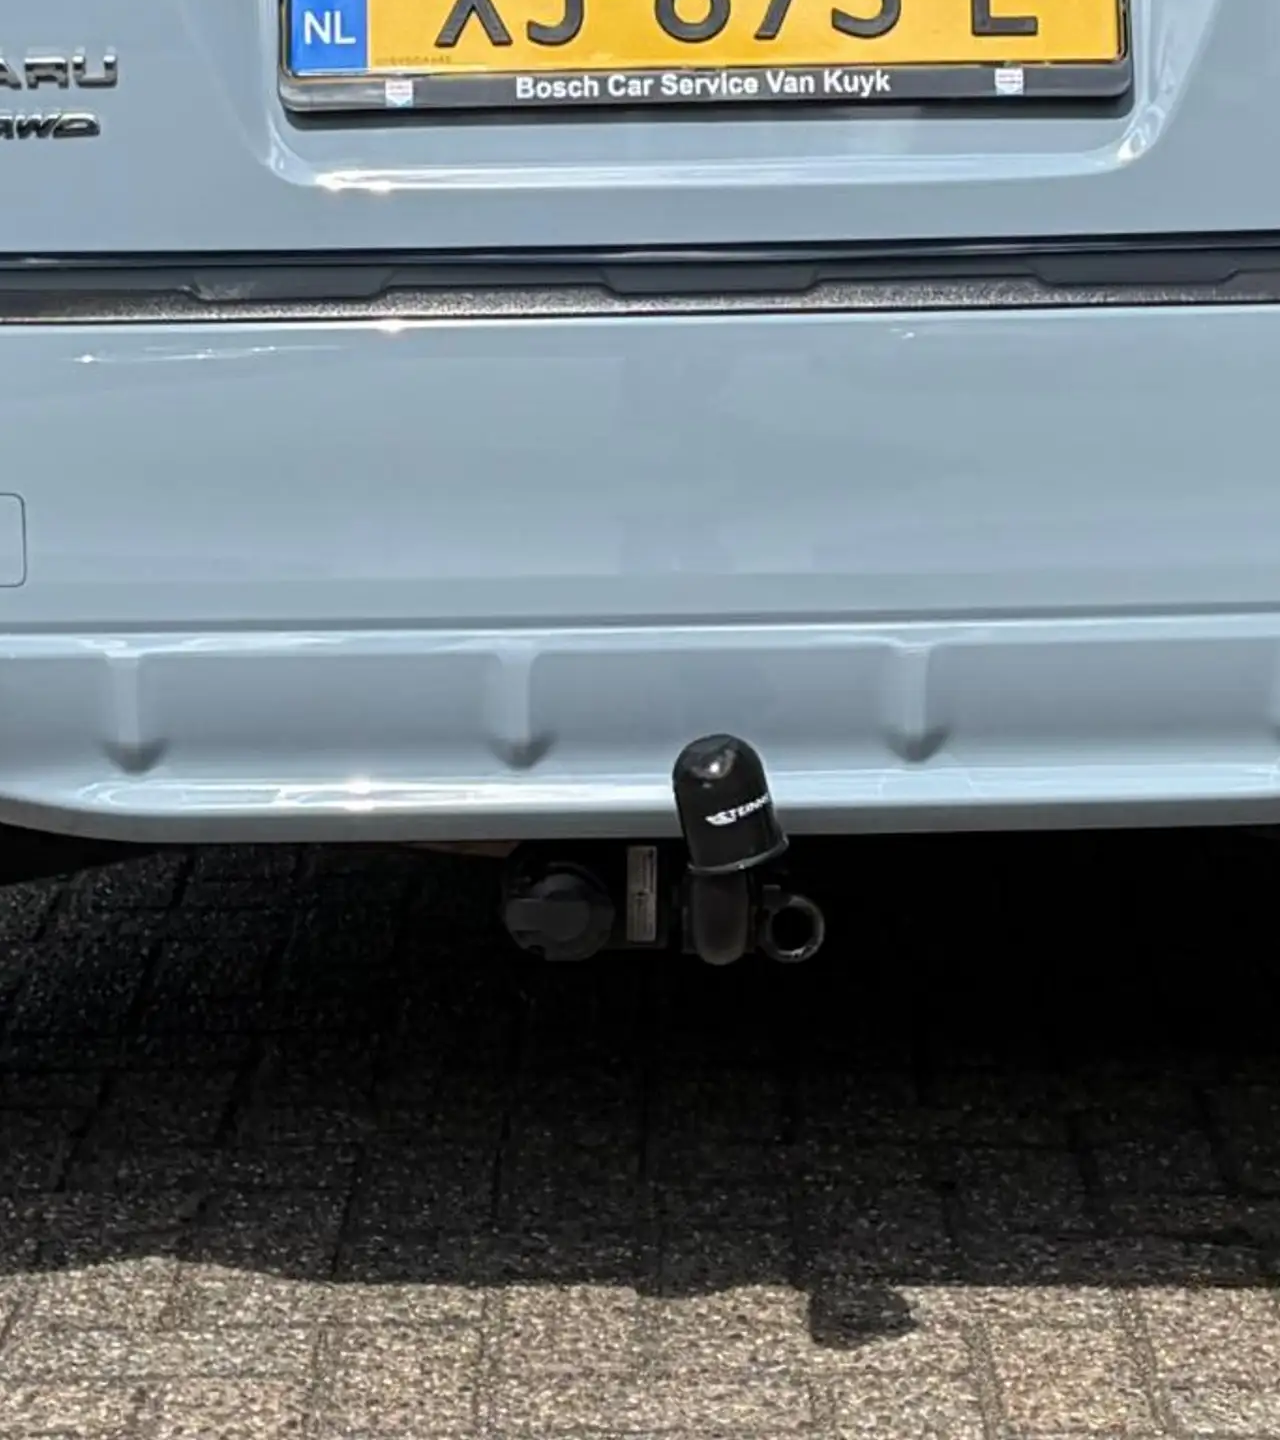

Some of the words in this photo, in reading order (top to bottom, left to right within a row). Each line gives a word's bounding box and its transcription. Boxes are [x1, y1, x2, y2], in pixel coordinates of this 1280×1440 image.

[303, 10, 357, 45] NL
[515, 74, 600, 99] Bosch
[607, 73, 654, 97] Car
[659, 70, 759, 98] Service
[765, 71, 815, 95] Van
[823, 68, 891, 99] Kuyk
